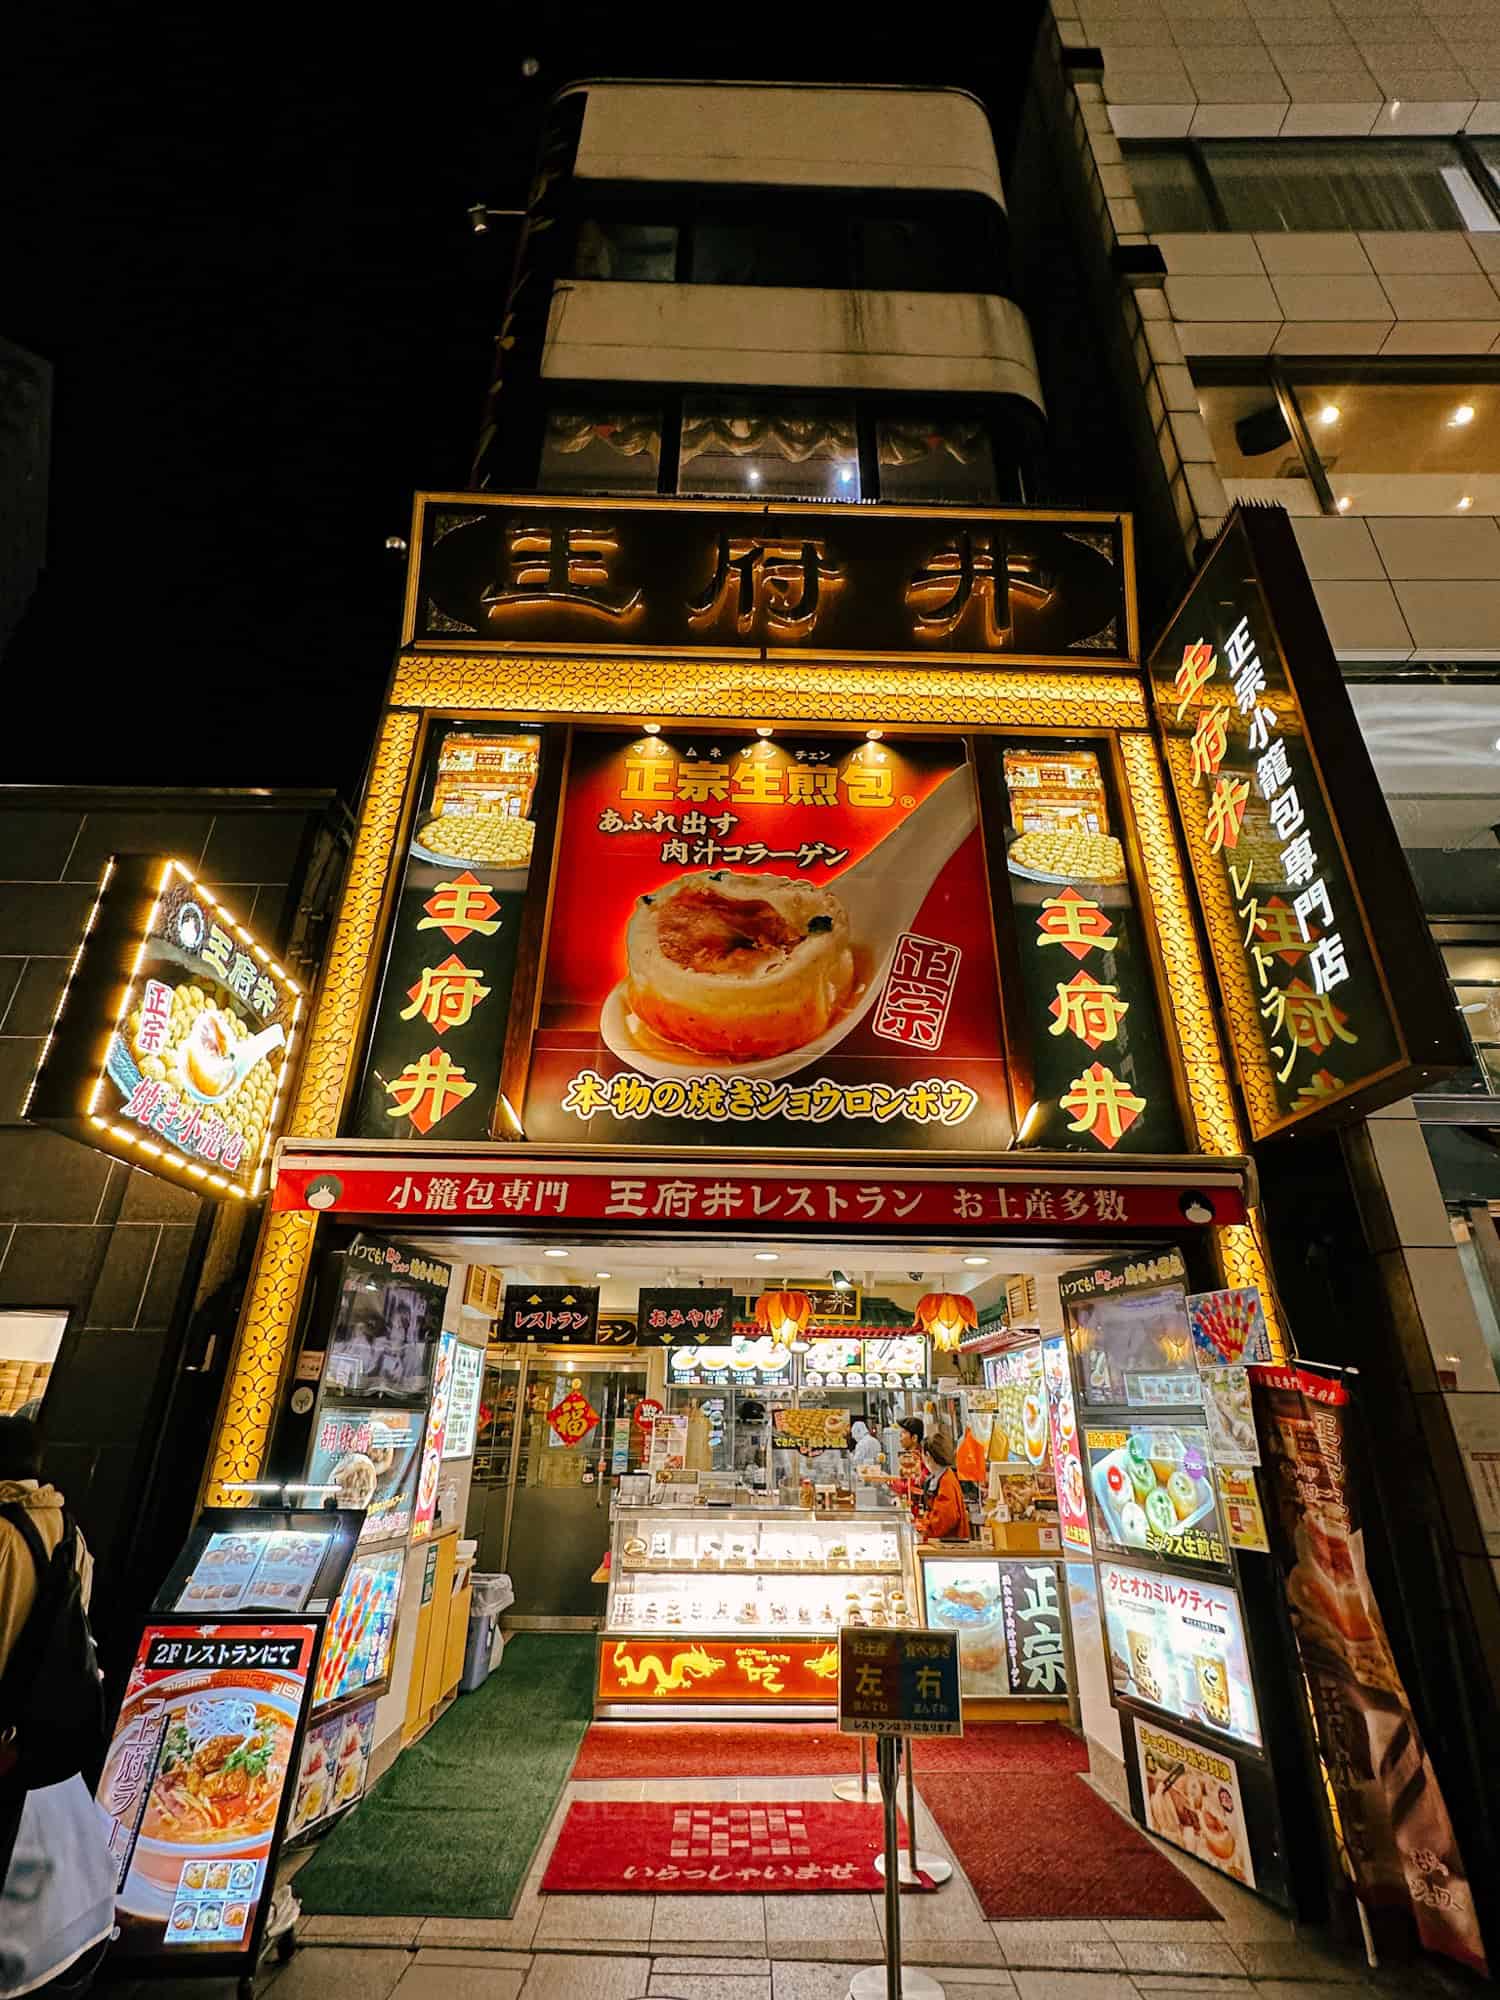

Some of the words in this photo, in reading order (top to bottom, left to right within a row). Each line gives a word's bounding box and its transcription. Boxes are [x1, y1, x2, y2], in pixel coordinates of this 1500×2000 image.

[480, 527, 1053, 647] 王府井
[1175, 638, 1249, 854] 王府井
[598, 809, 738, 836] あふれ出す
[660, 840, 849, 866] 肉汁コラーゲン
[201, 923, 277, 1018] 王府井
[1229, 860, 1298, 1083] レストラン
[139, 983, 172, 1053] 正宗
[385, 882, 503, 1124] 王府井
[1036, 898, 1147, 1137] 王府井
[563, 1070, 978, 1126] 本物の焼きショウロンポウ
[603, 1178, 923, 1219] 王府井レストラン
[952, 1187, 1129, 1223] お土産多数
[514, 1310, 590, 1331] レストラン
[648, 1307, 725, 1330] おみやげ
[555, 1400, 589, 1438] 福
[855, 1663, 883, 1697] 左
[915, 1665, 943, 1699] 右
[623, 1863, 859, 1882] いらっしゃいませ
